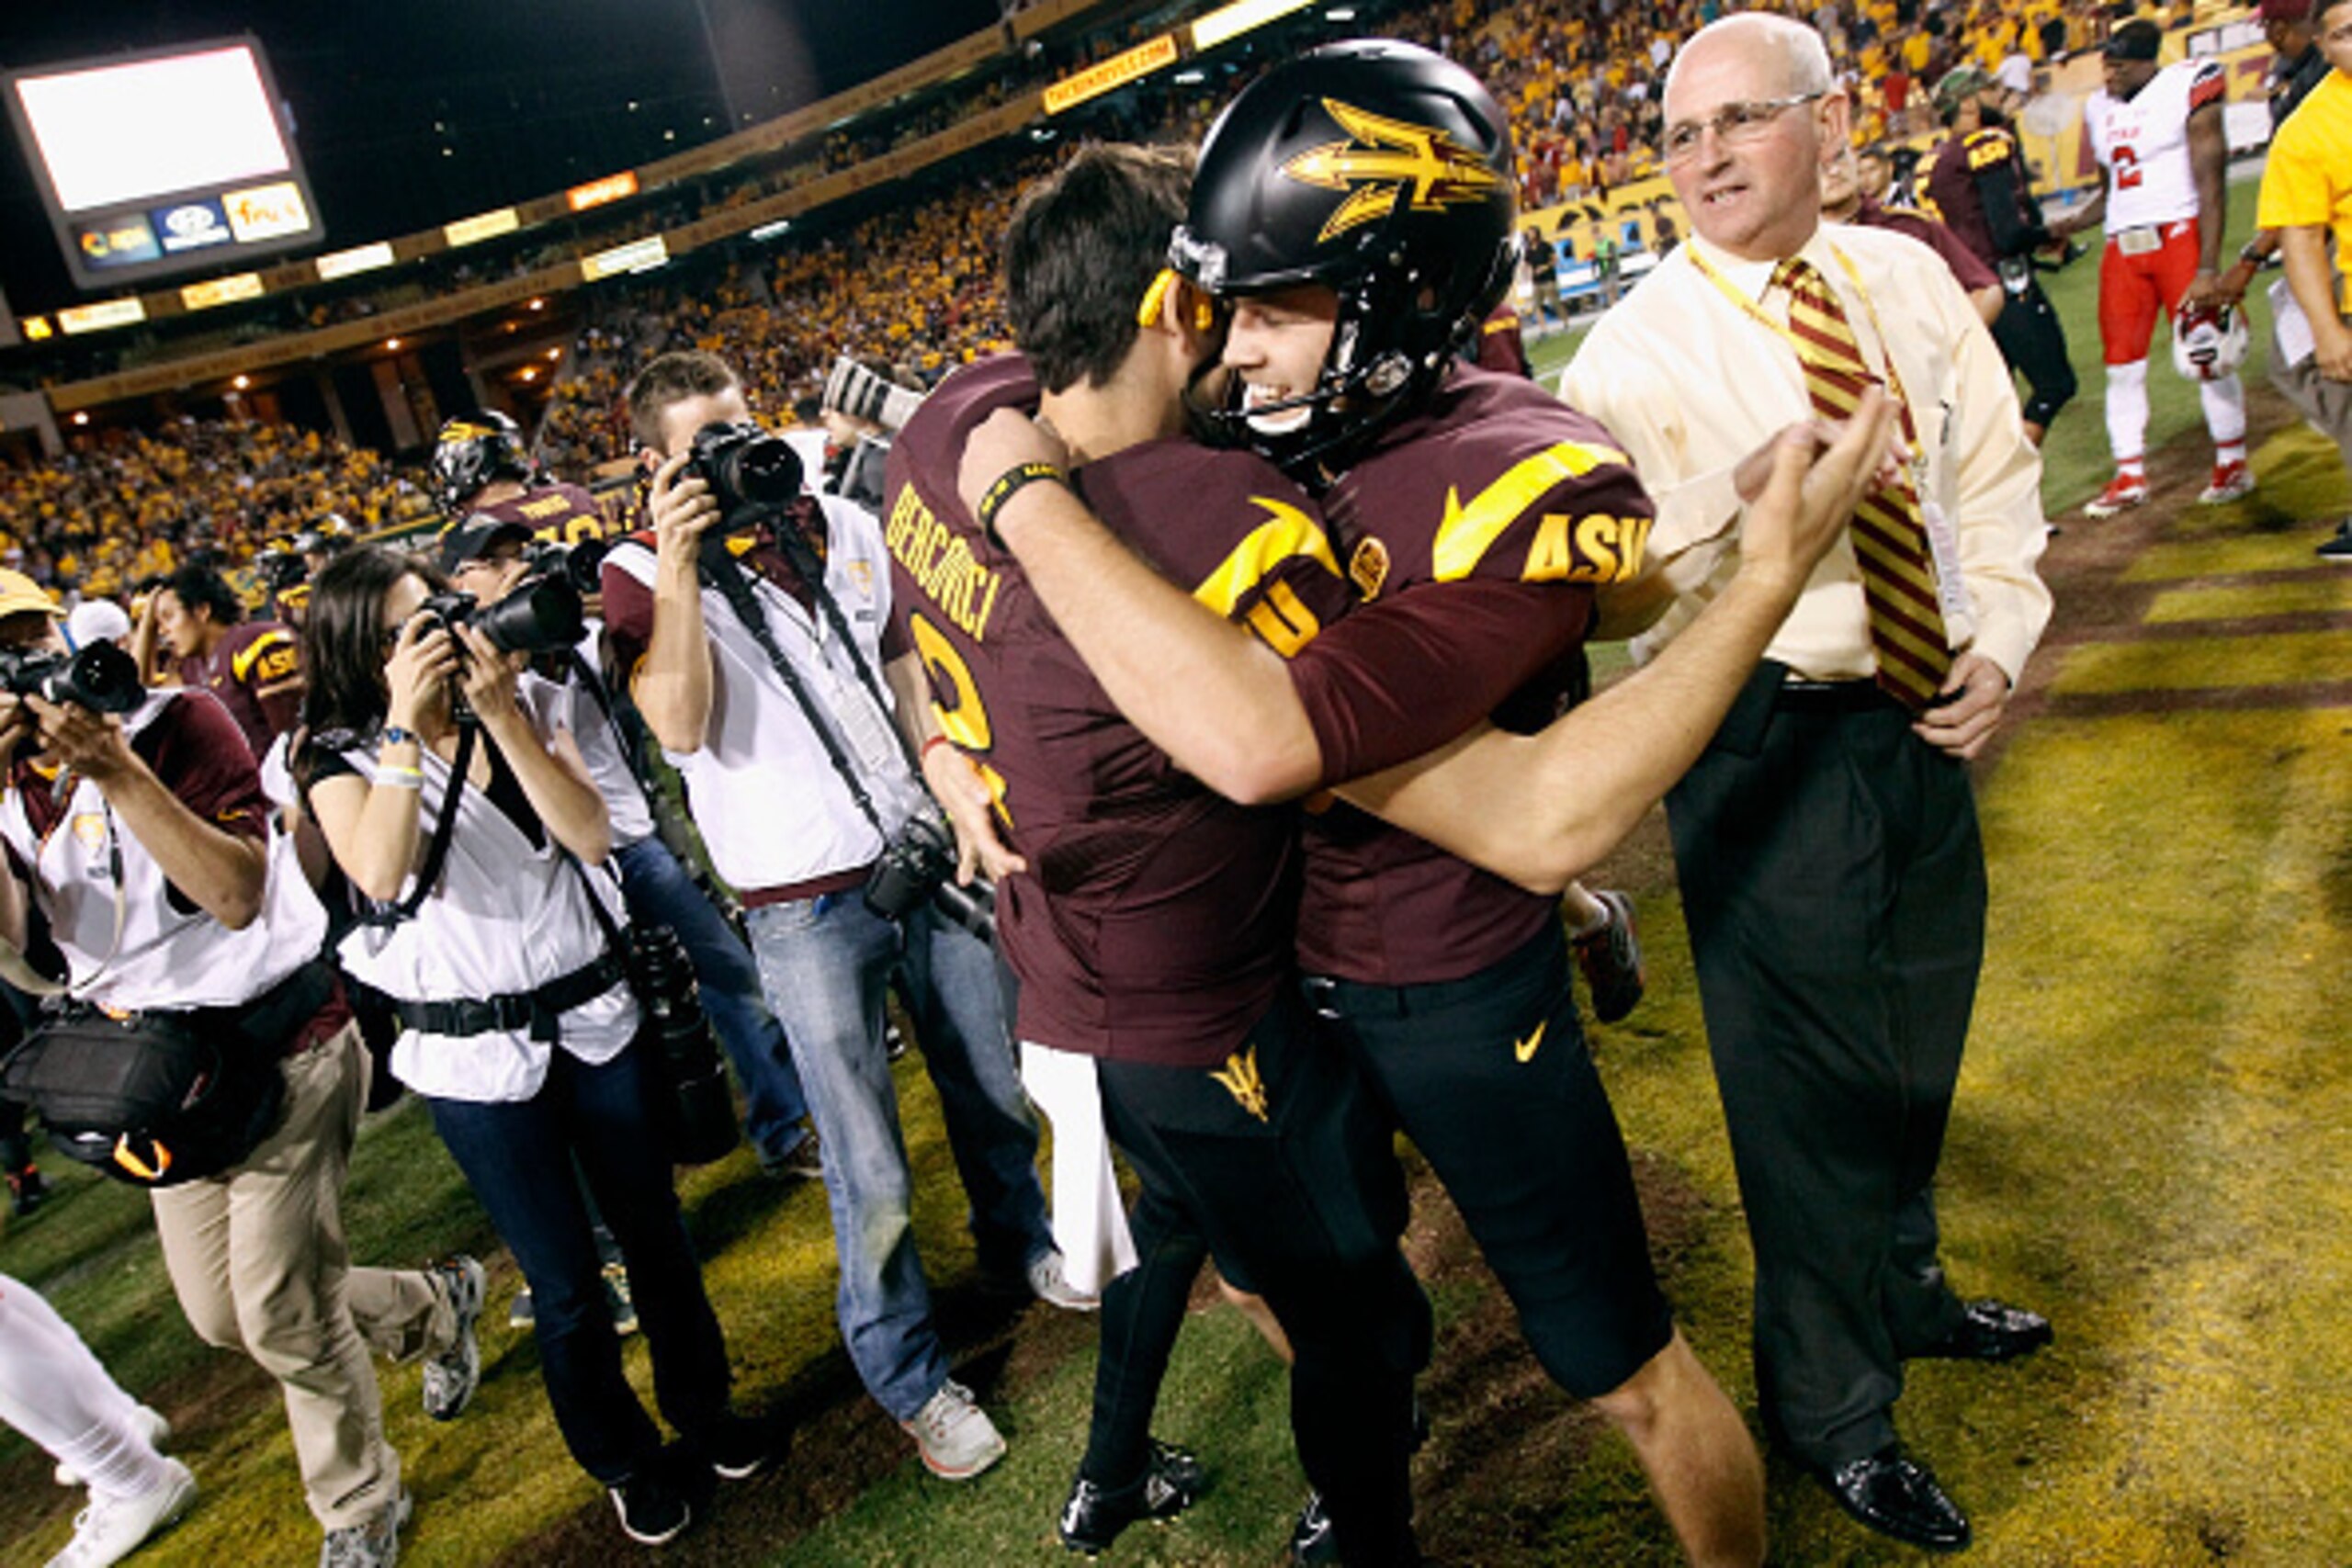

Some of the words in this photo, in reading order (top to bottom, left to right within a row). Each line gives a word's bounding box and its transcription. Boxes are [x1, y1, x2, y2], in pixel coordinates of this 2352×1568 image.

[2112, 145, 2143, 190] 2
[887, 480, 1001, 642] BERCOVICI
[1521, 513, 1652, 583] ASU
